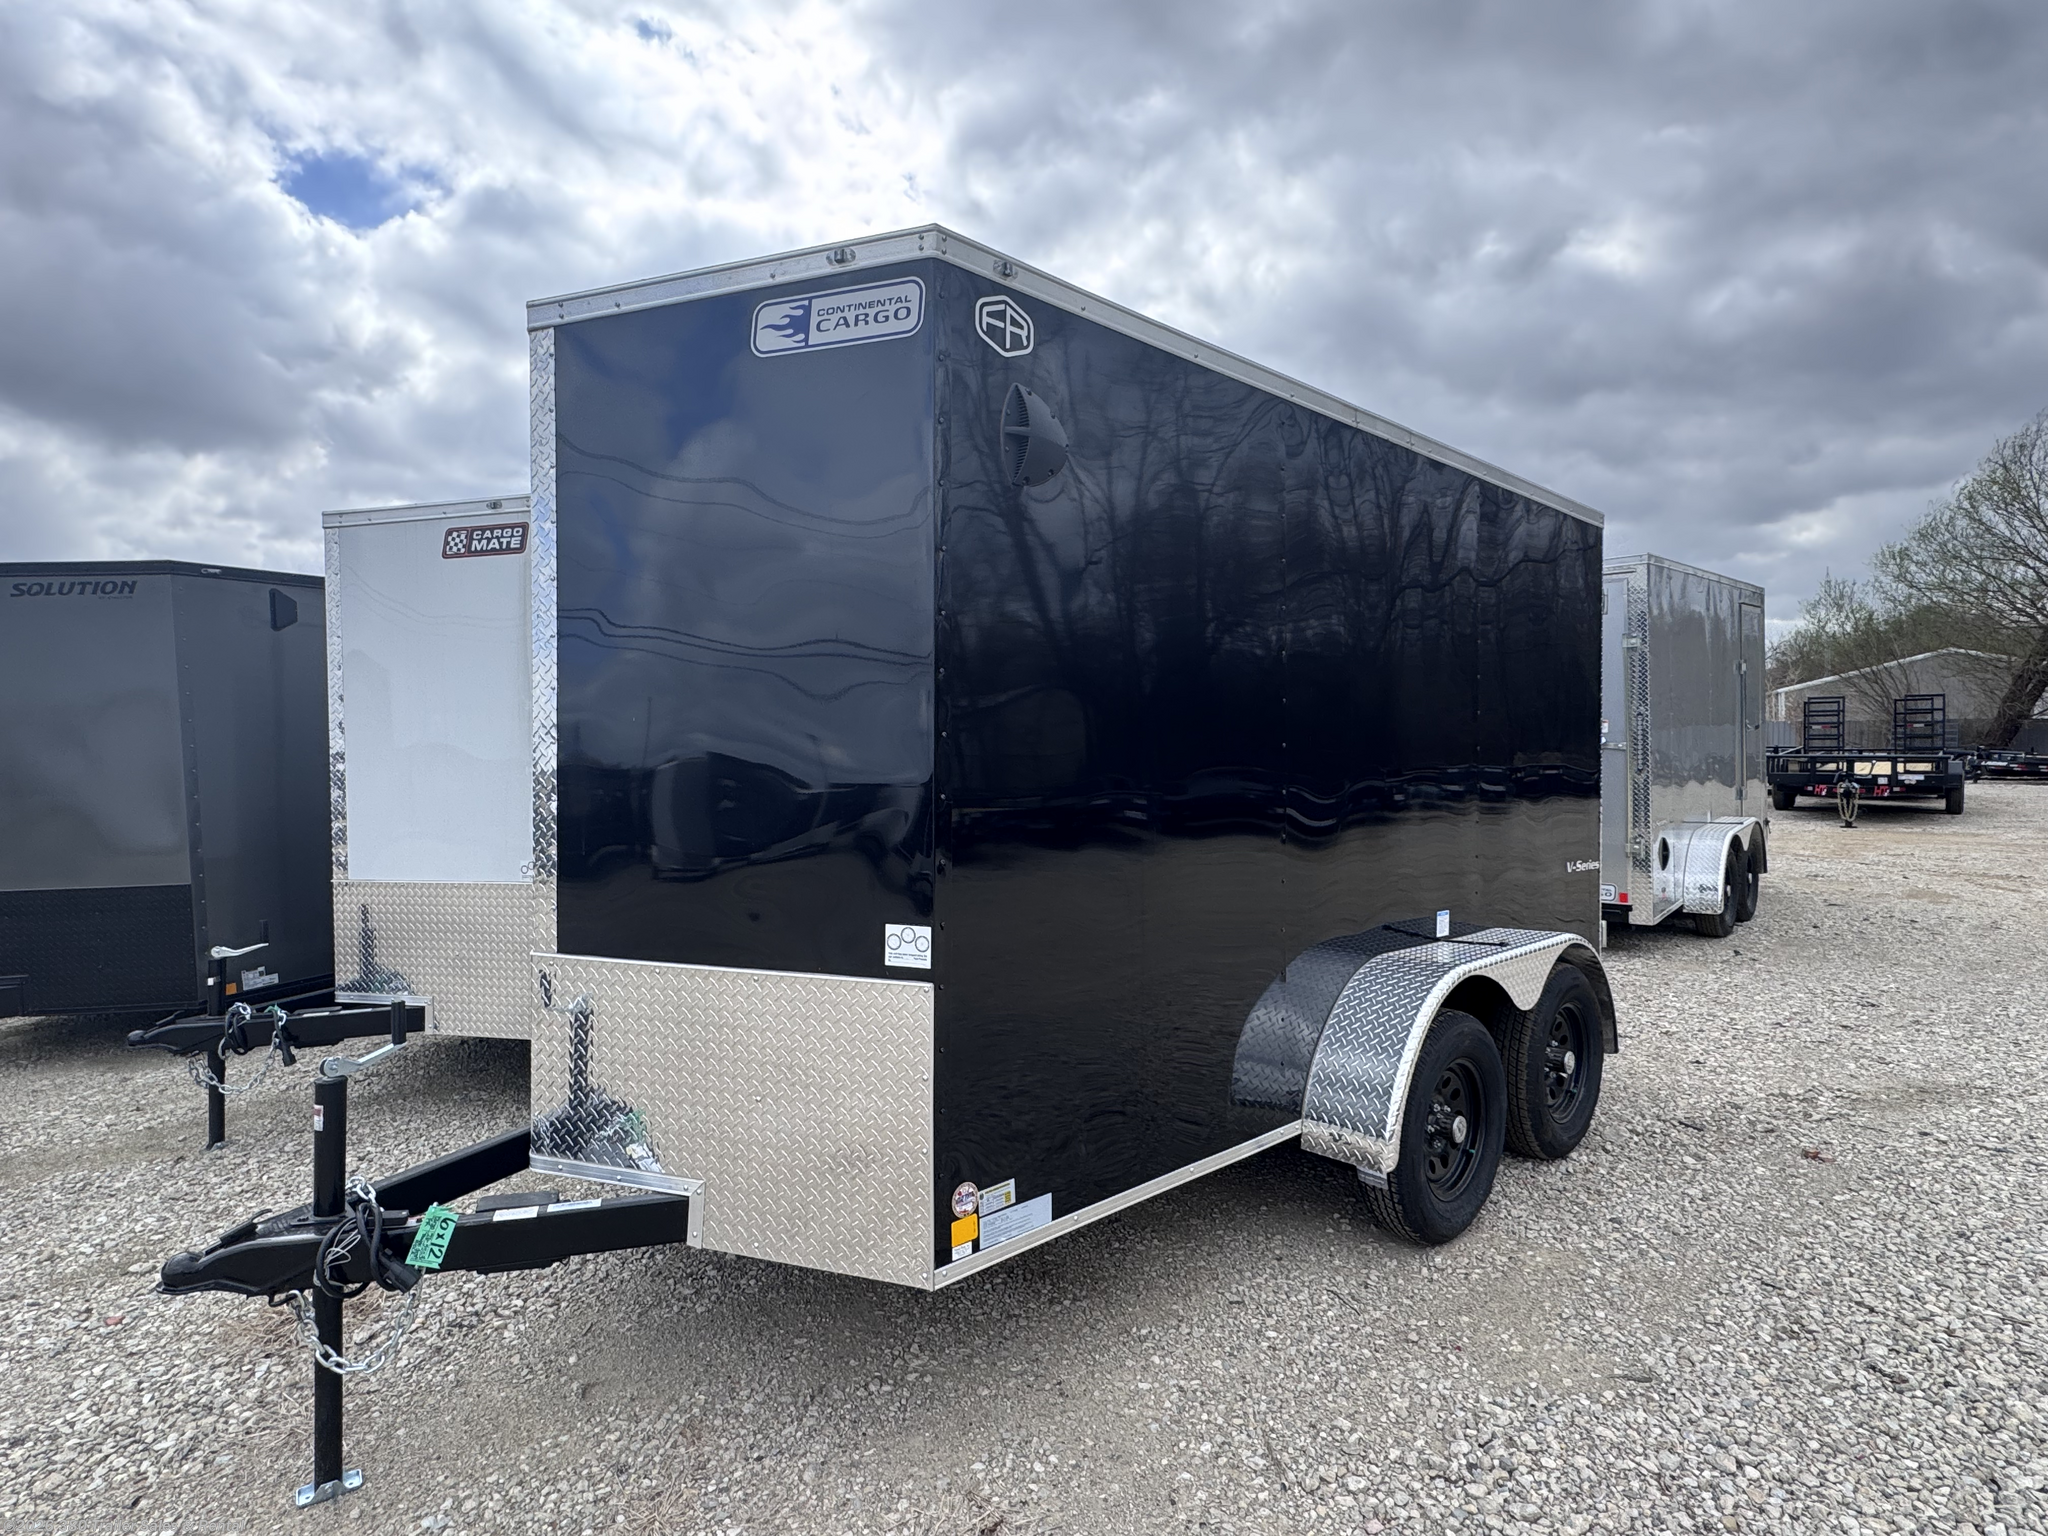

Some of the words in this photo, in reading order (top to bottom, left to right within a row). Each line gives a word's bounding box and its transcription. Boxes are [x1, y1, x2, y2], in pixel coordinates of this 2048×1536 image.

[816, 294, 912, 317] CONTINENTAL
[815, 306, 912, 333] CARGO
[982, 303, 1029, 350] FR
[472, 527, 523, 540] CARGO
[470, 537, 522, 552] MATE
[10, 580, 138, 598] SOLUTION
[1566, 859, 1600, 873] V-Series
[439, 1217, 457, 1231] 6
[427, 1242, 445, 1260] 12
